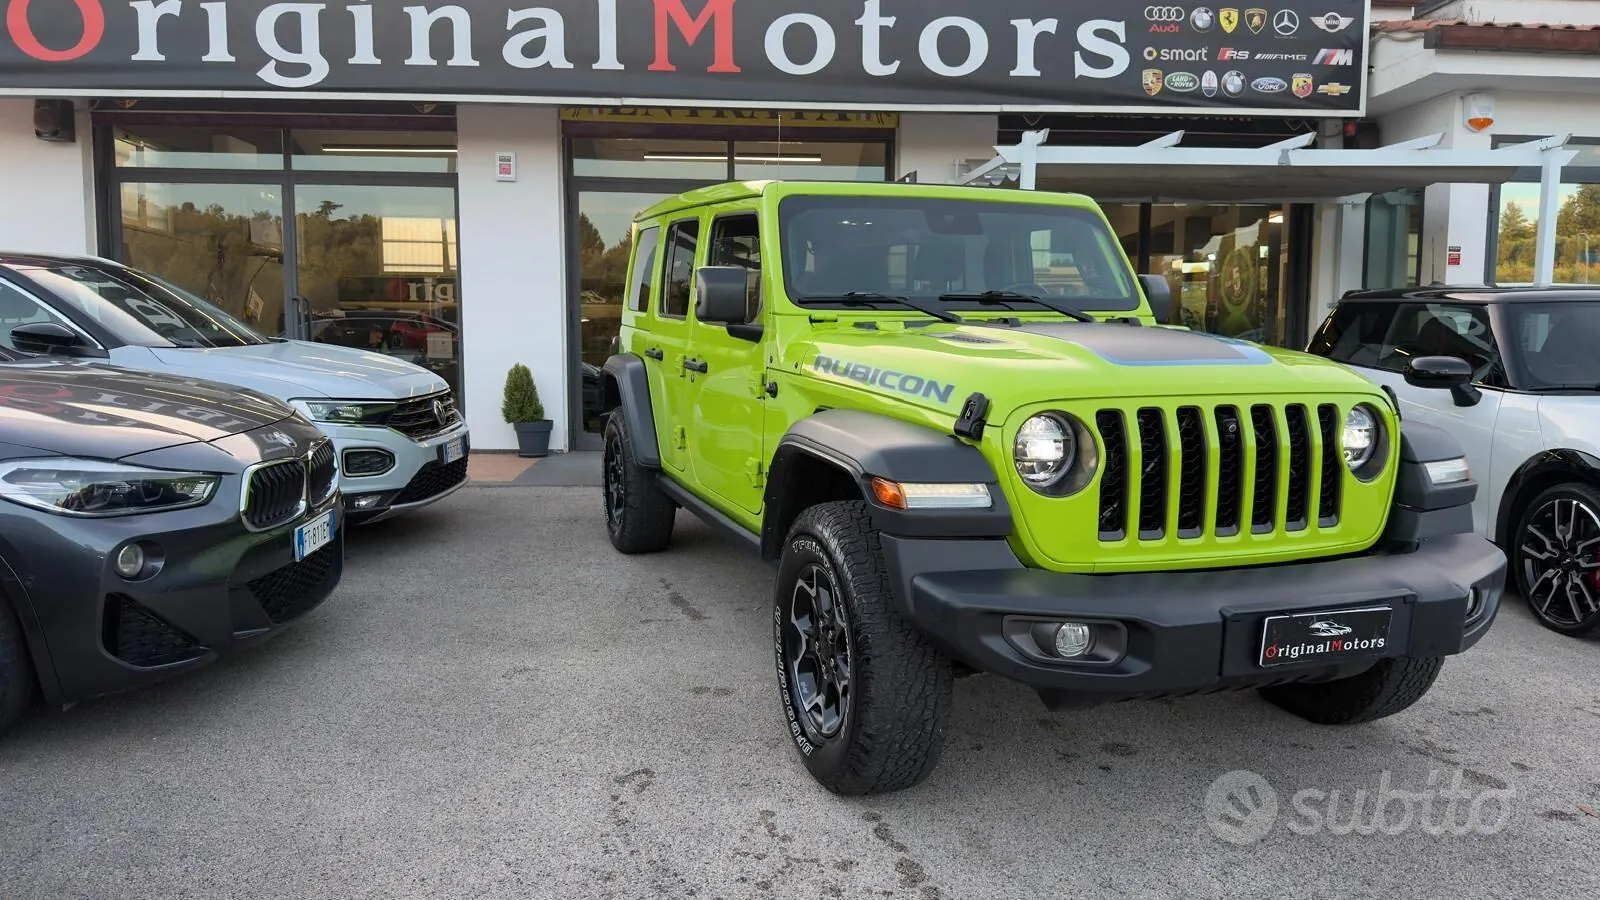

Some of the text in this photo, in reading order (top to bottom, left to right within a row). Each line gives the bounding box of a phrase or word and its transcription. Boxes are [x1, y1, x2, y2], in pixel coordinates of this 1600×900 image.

[1149, 24, 1180, 32] Audi
[1160, 47, 1208, 60] smart
[1224, 50, 1250, 60] RS
[1257, 78, 1280, 90] Ford
[813, 354, 956, 404] RUBICON
[1265, 637, 1386, 659] OriginalMotors
